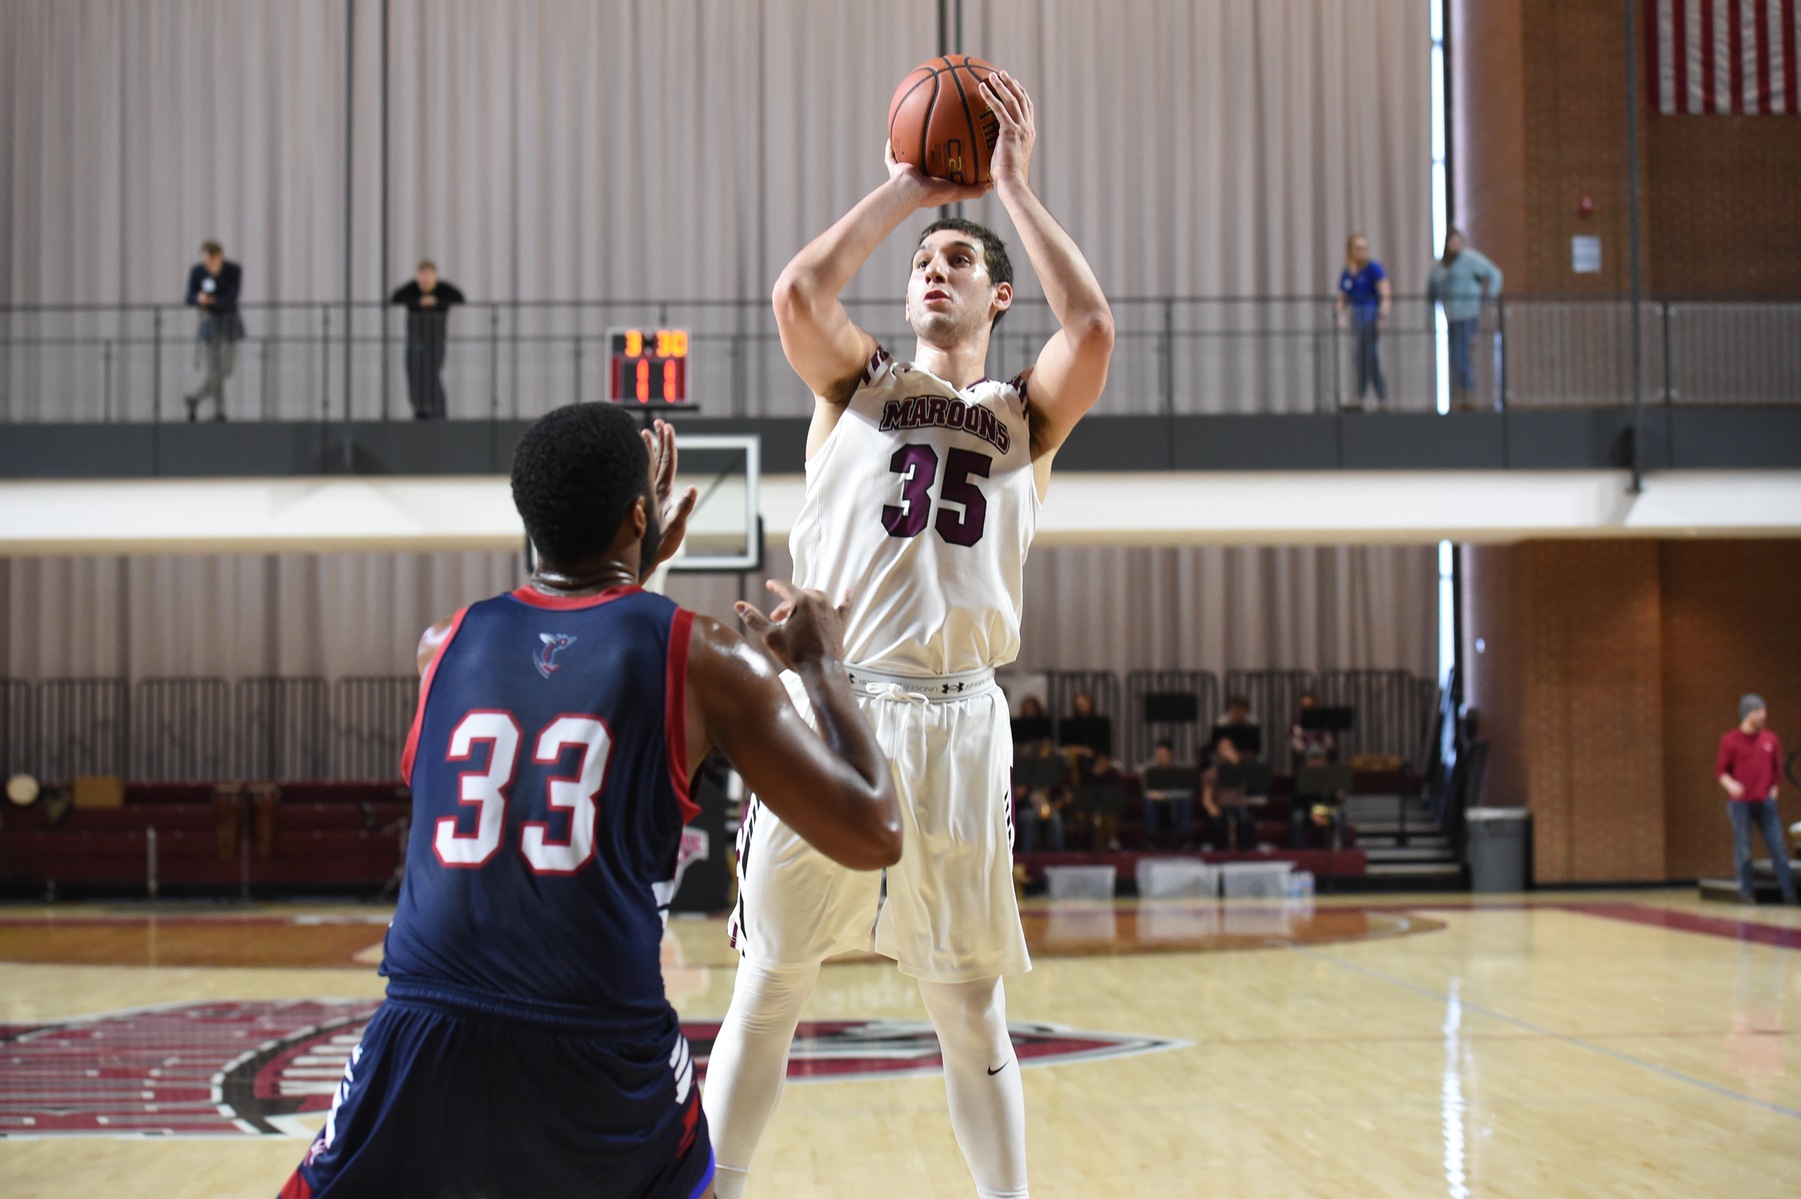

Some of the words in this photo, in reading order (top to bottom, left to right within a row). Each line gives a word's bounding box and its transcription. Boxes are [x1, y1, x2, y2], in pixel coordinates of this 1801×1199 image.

[636, 358, 677, 404] 11
[879, 395, 1010, 454] MAROONS
[881, 443, 993, 547] 35
[432, 709, 616, 876] 33
